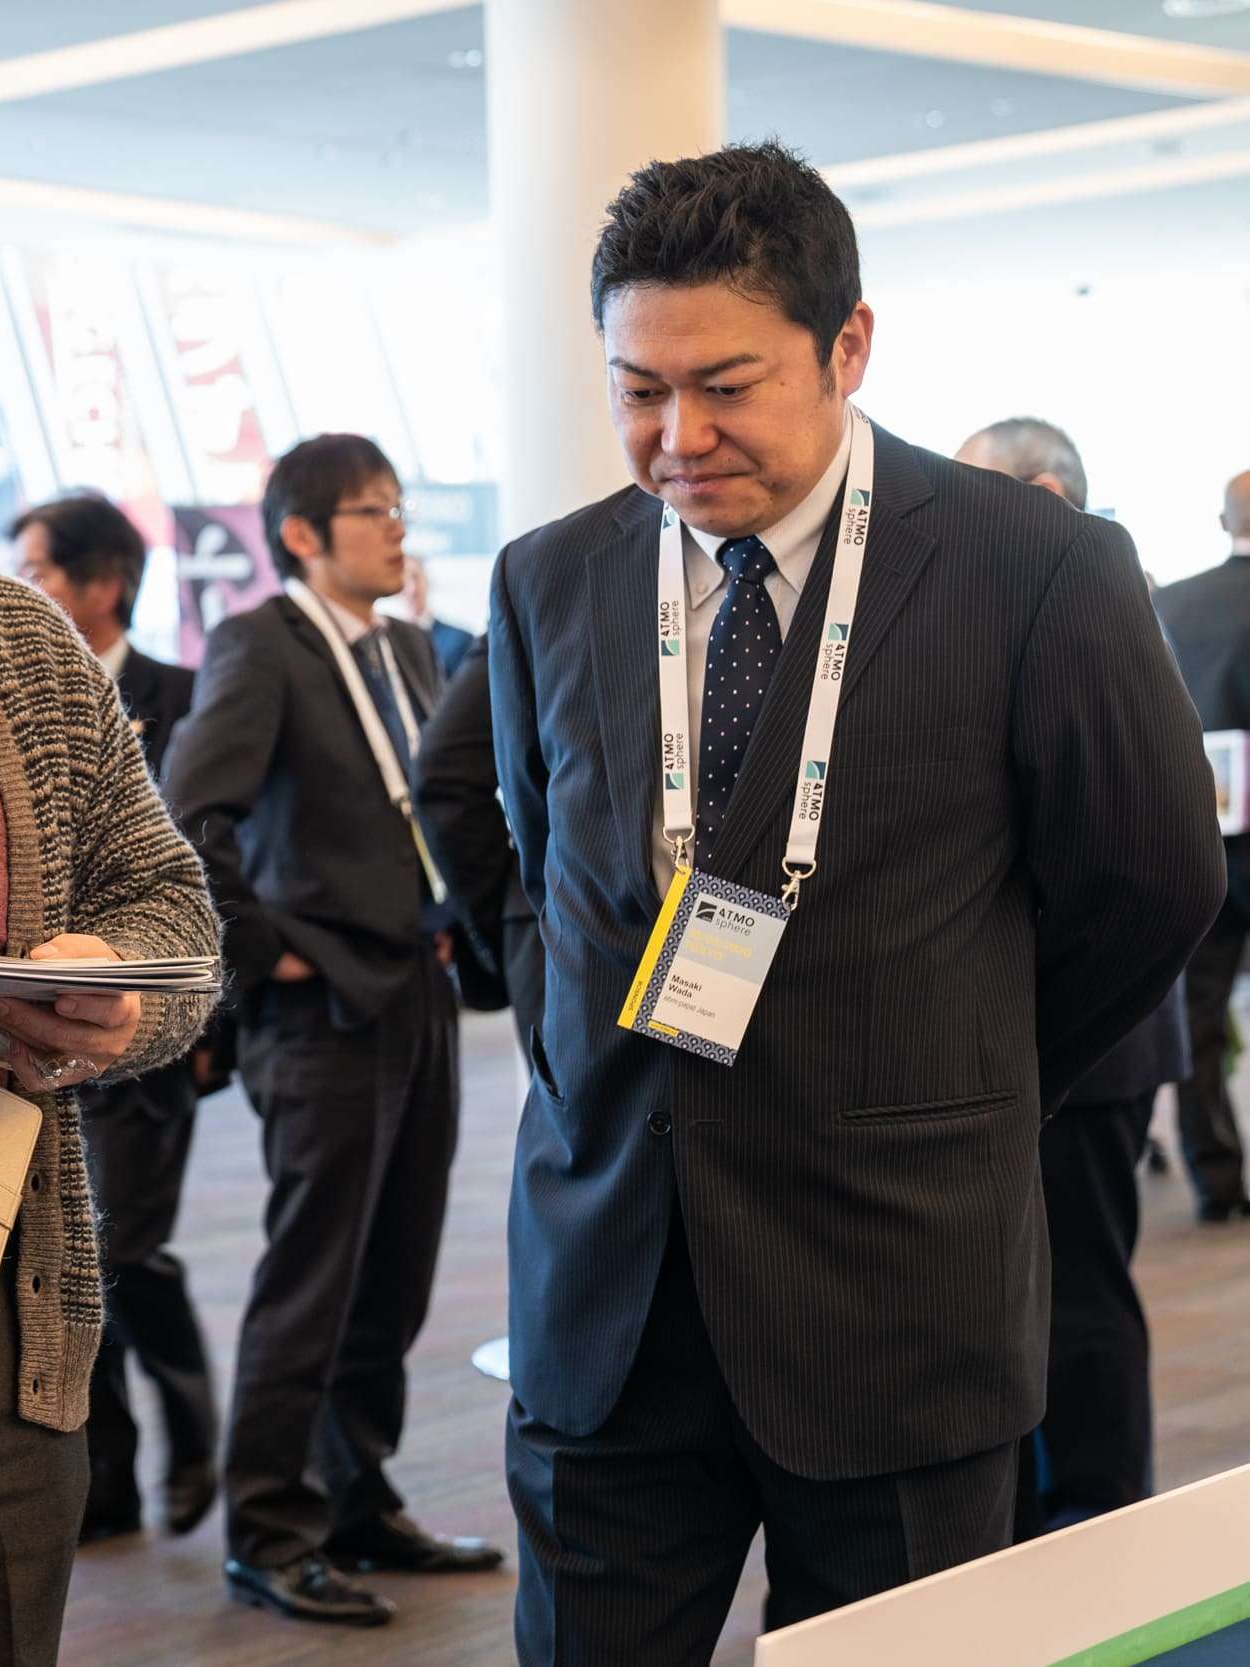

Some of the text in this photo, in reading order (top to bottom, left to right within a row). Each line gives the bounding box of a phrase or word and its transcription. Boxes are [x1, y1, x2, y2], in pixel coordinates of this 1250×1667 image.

[843, 507, 857, 545] sphere
[853, 508, 869, 546] ATMO
[660, 601, 671, 637] ATMO
[670, 600, 680, 636] sphere
[820, 642, 834, 680] sphere
[830, 642, 846, 681] ATMO
[663, 732, 675, 770] ATMO
[675, 732, 686, 769] sphere
[798, 781, 813, 820] sphere
[808, 782, 824, 822] ATMO
[715, 917, 752, 937] sphere
[718, 908, 756, 928] ATMO
[668, 982, 693, 999] Wada
[671, 973, 703, 992] Masaki
